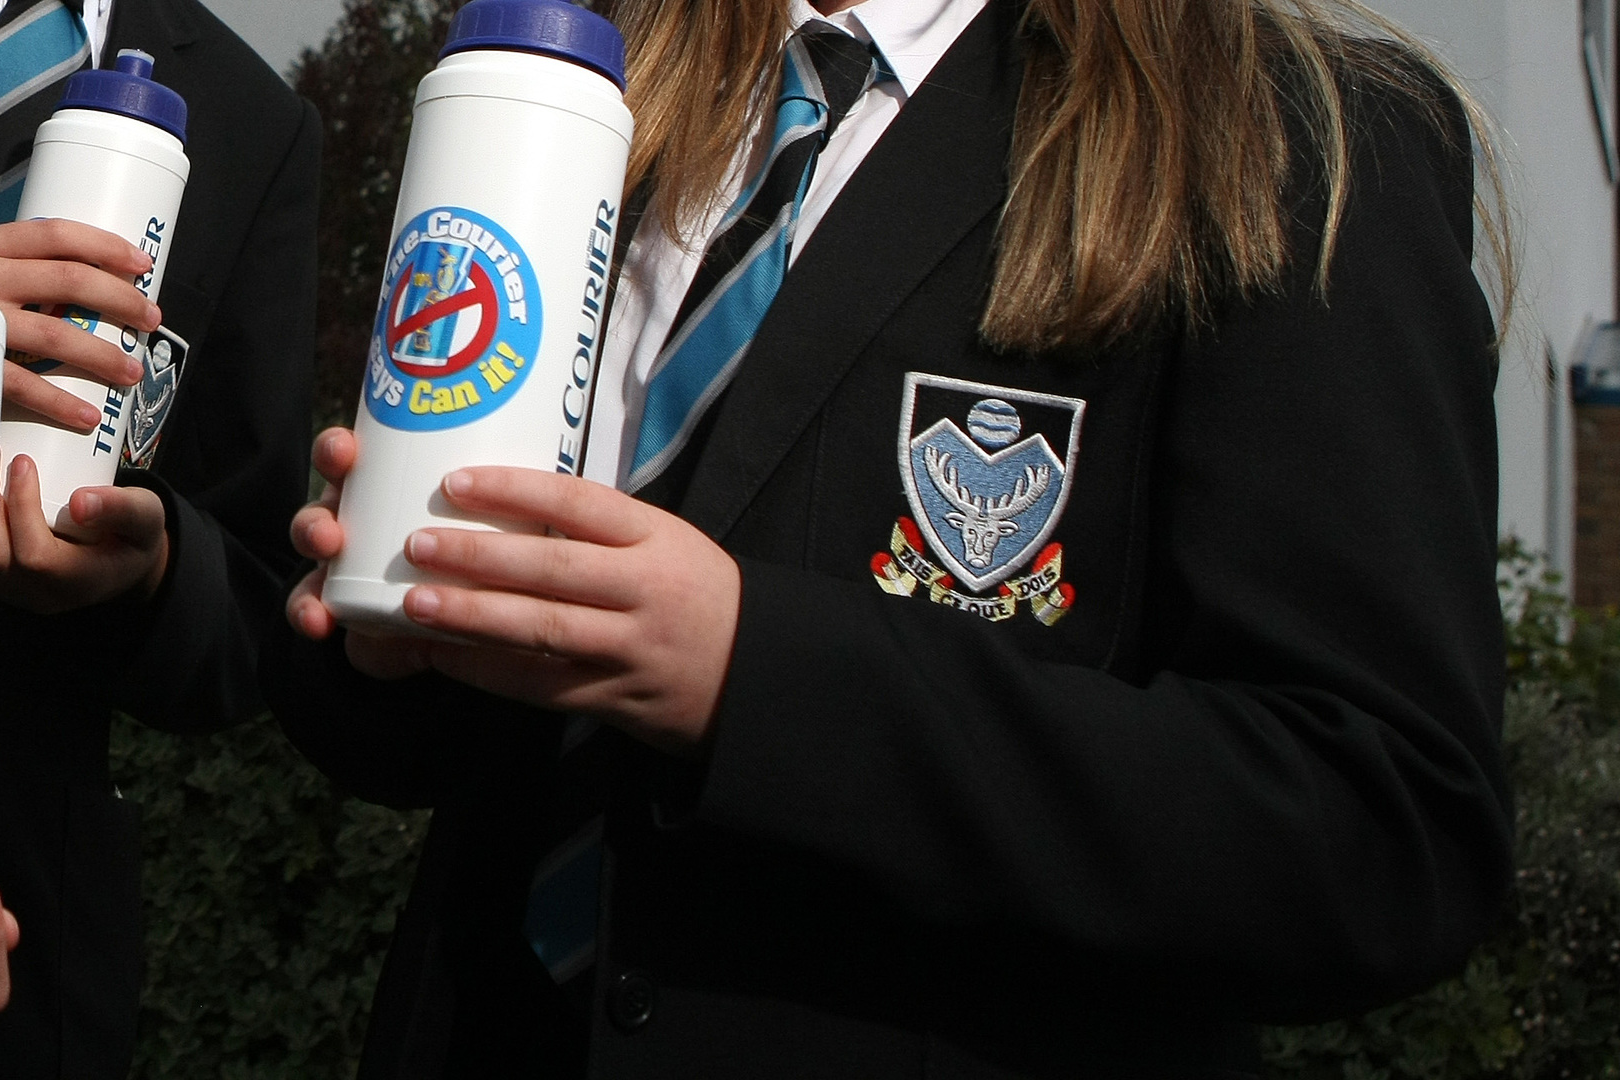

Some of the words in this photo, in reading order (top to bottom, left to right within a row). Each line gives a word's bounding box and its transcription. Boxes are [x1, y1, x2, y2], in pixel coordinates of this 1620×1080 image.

[427, 211, 527, 325] Courier
[561, 198, 616, 430] COURIER
[408, 379, 482, 415] Can
[478, 341, 526, 394] it!
[1017, 564, 1058, 598] DOIS
